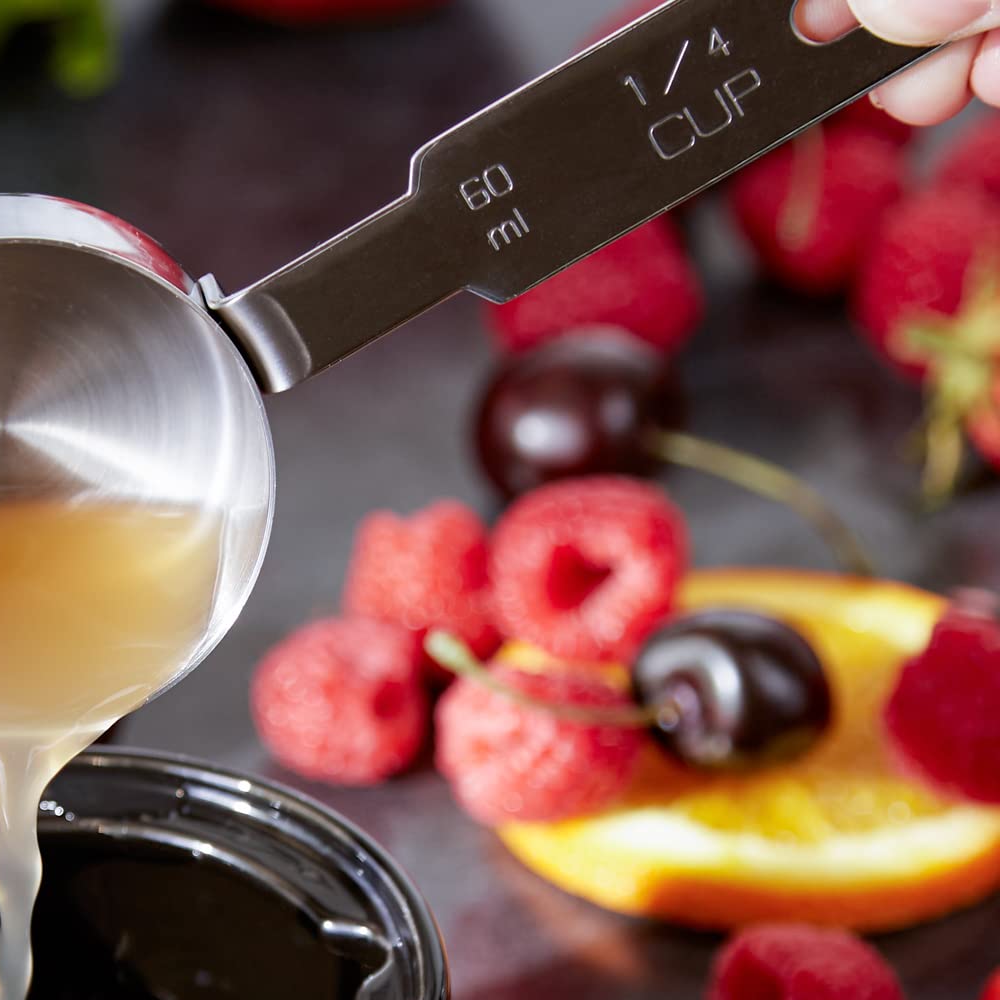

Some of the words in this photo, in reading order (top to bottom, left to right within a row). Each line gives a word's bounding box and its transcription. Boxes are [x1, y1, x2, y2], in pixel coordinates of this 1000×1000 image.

[624, 27, 730, 105] 1/4
[649, 67, 761, 160] CUP
[458, 163, 514, 211] 60
[487, 207, 530, 250] ml
